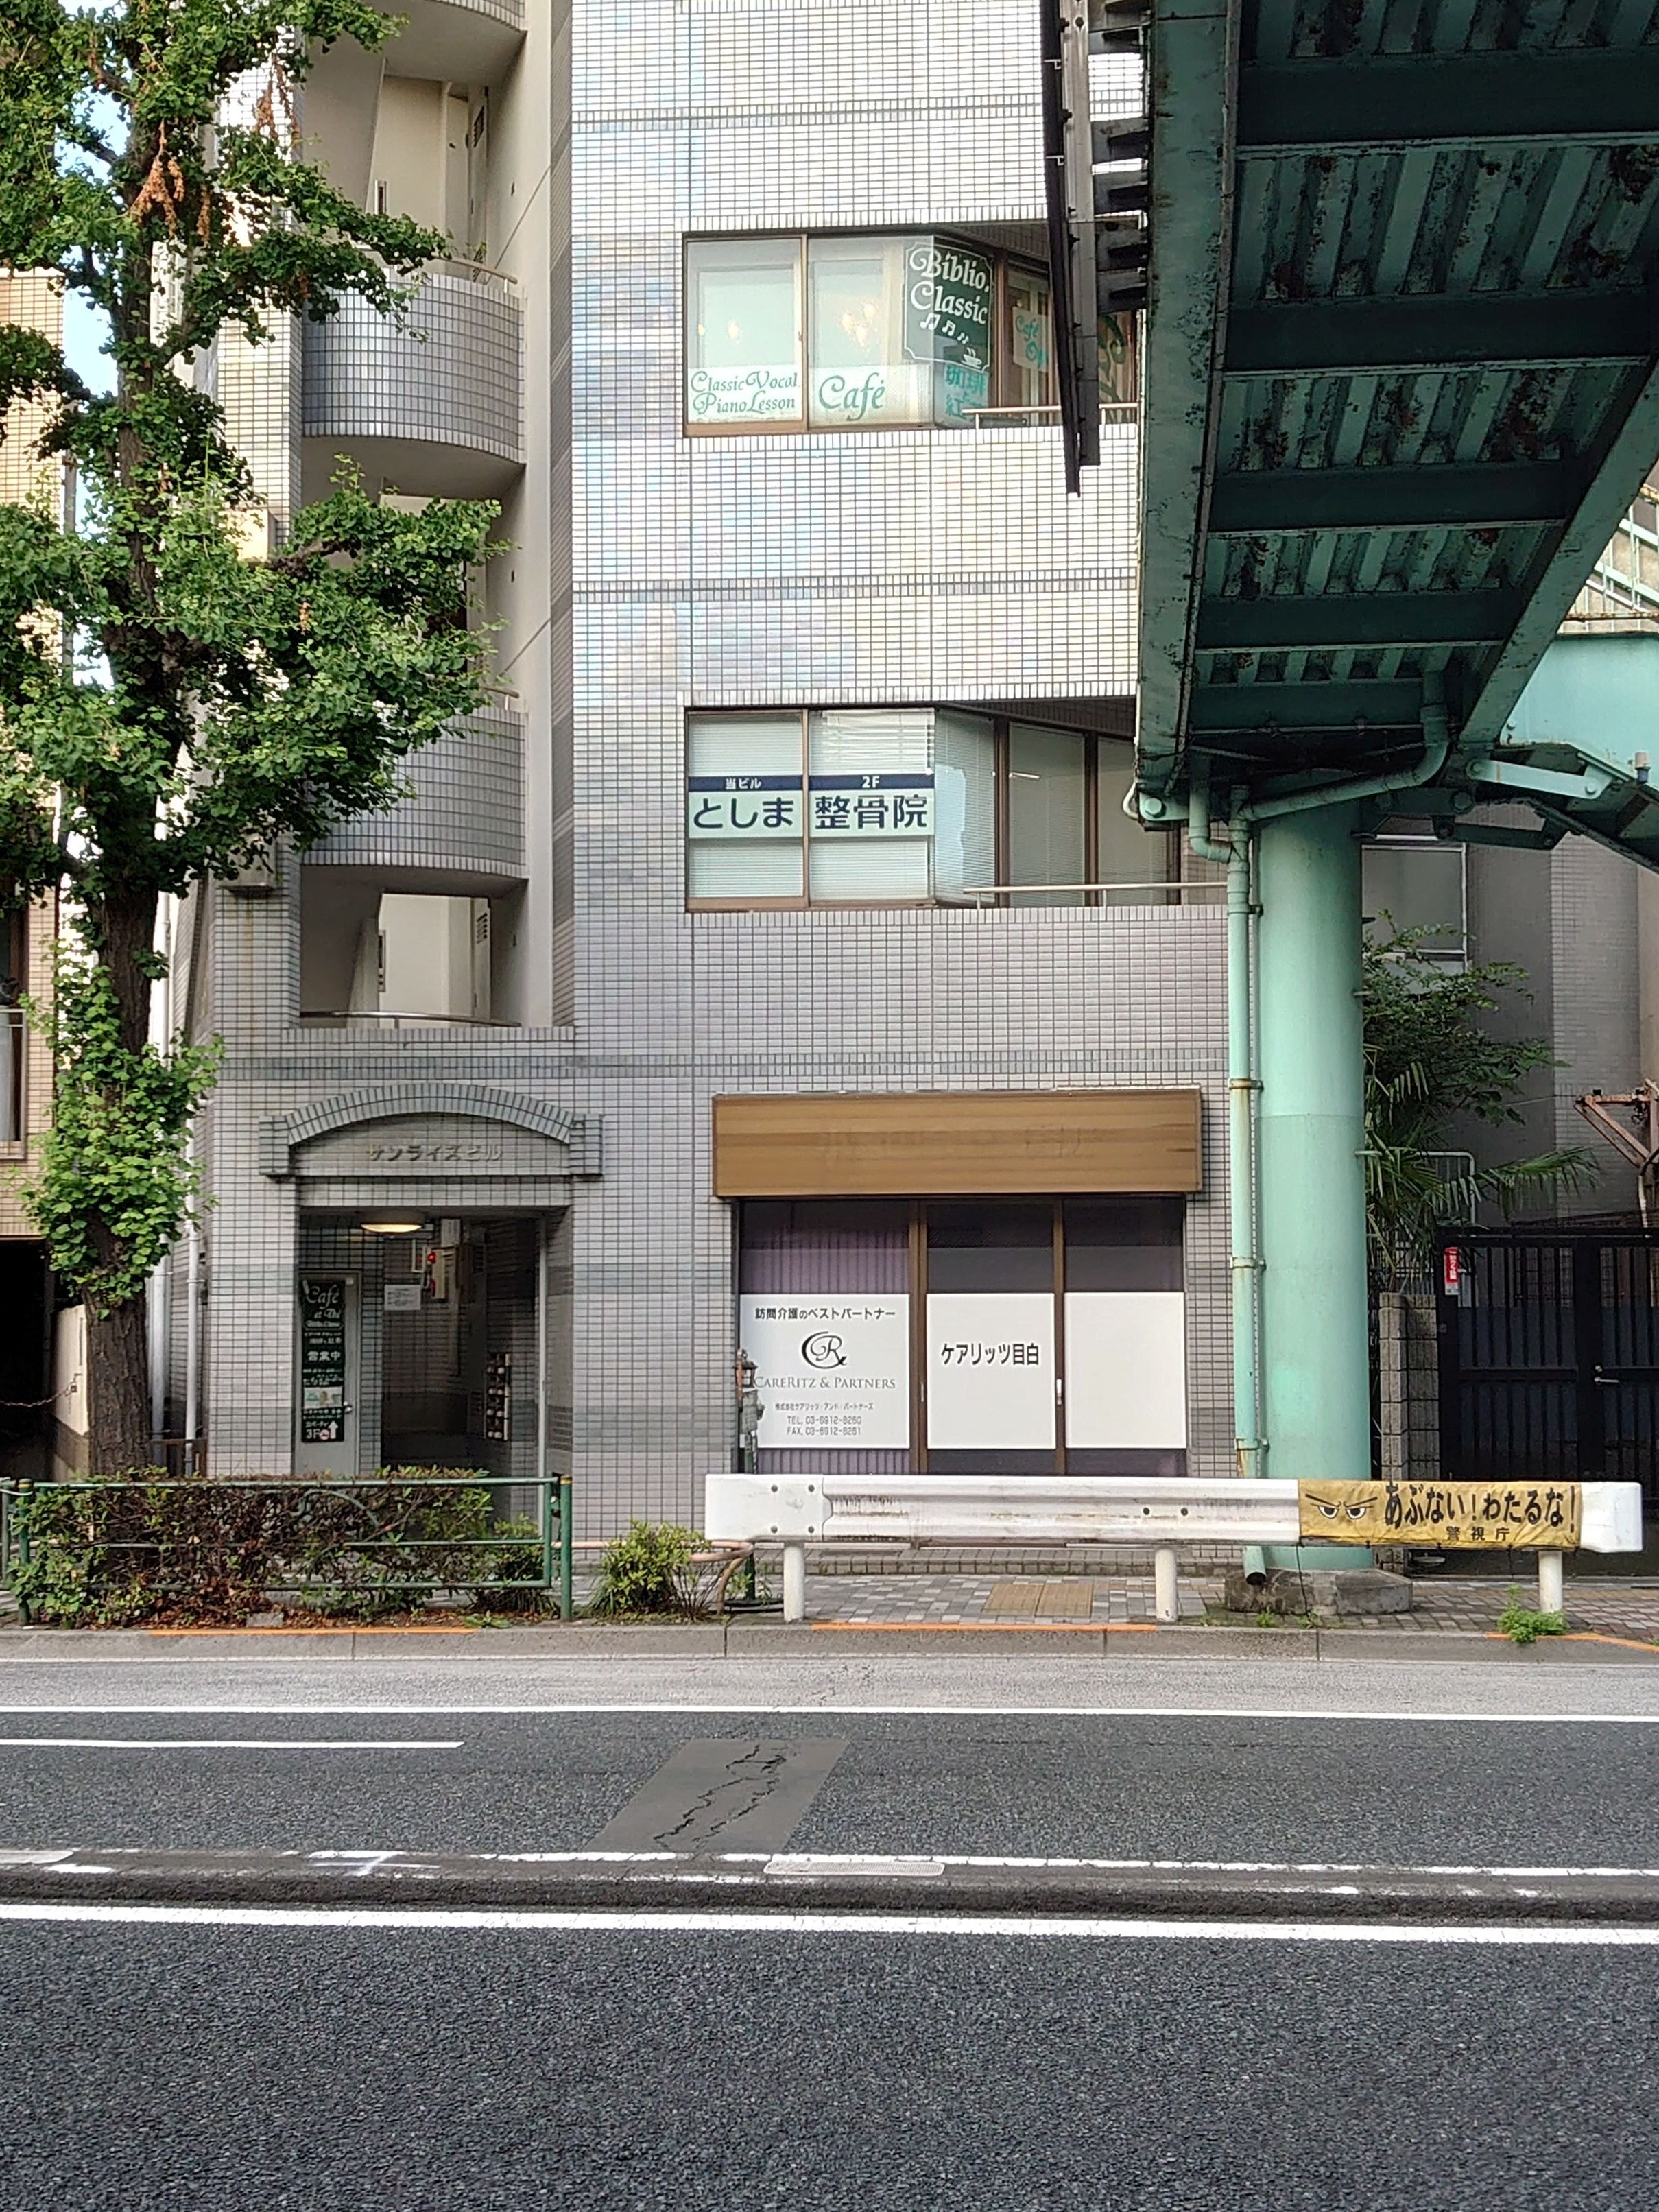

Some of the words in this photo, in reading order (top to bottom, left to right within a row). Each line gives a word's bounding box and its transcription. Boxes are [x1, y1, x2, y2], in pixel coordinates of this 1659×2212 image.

[911, 281, 988, 324] Classic
[691, 371, 745, 392] Classic
[745, 370, 798, 389] Vocal
[693, 392, 747, 414] Piano
[747, 390, 795, 414] Lesson
[819, 372, 885, 421] Café
[862, 776, 879, 788] 2F
[693, 797, 794, 829] としま
[815, 794, 927, 829] 整骨院
[755, 1307, 896, 1320] 訪問介護のベストパートナー
[941, 1343, 1039, 1365] ケアリッツ目白
[820, 1377, 829, 1388] &
[1445, 1527, 1510, 1541] 警視庁
